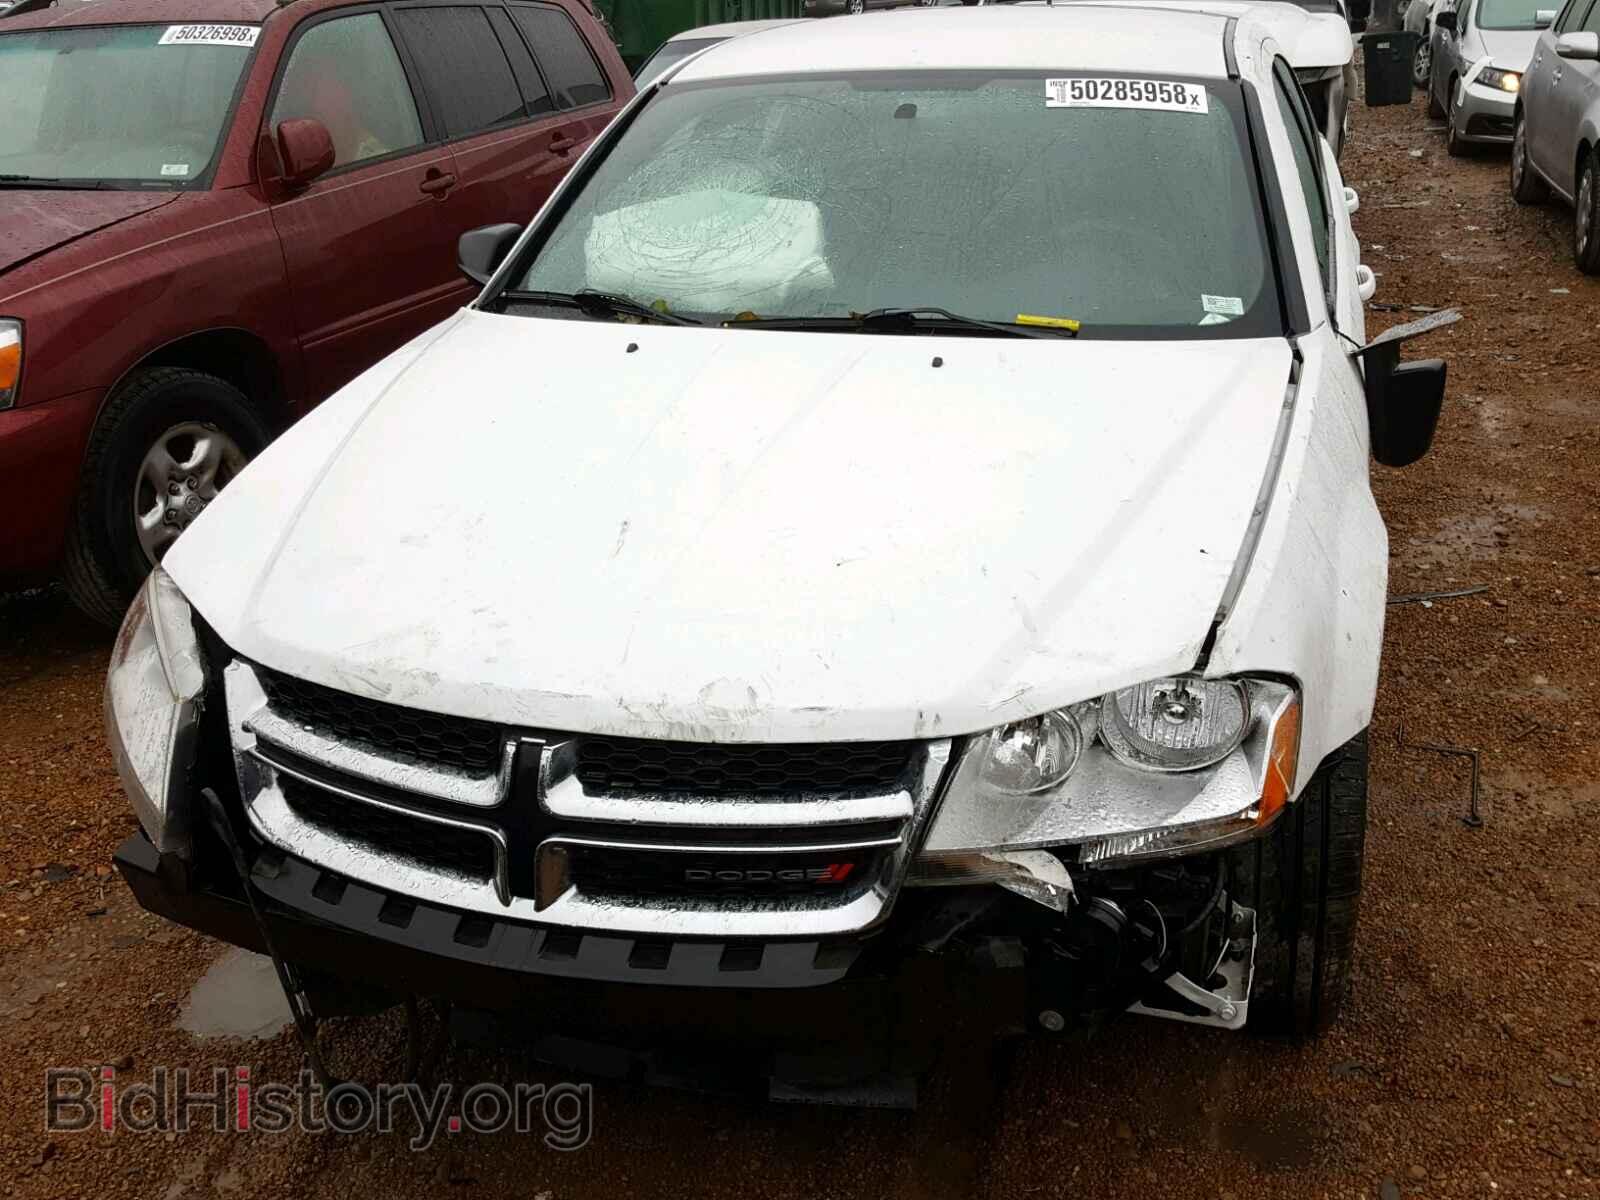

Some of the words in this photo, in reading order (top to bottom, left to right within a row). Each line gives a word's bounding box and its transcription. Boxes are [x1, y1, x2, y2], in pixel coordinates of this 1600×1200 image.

[175, 25, 251, 42] 50326998
[1070, 79, 1187, 105] 50285958
[684, 868, 833, 882] DODGE
